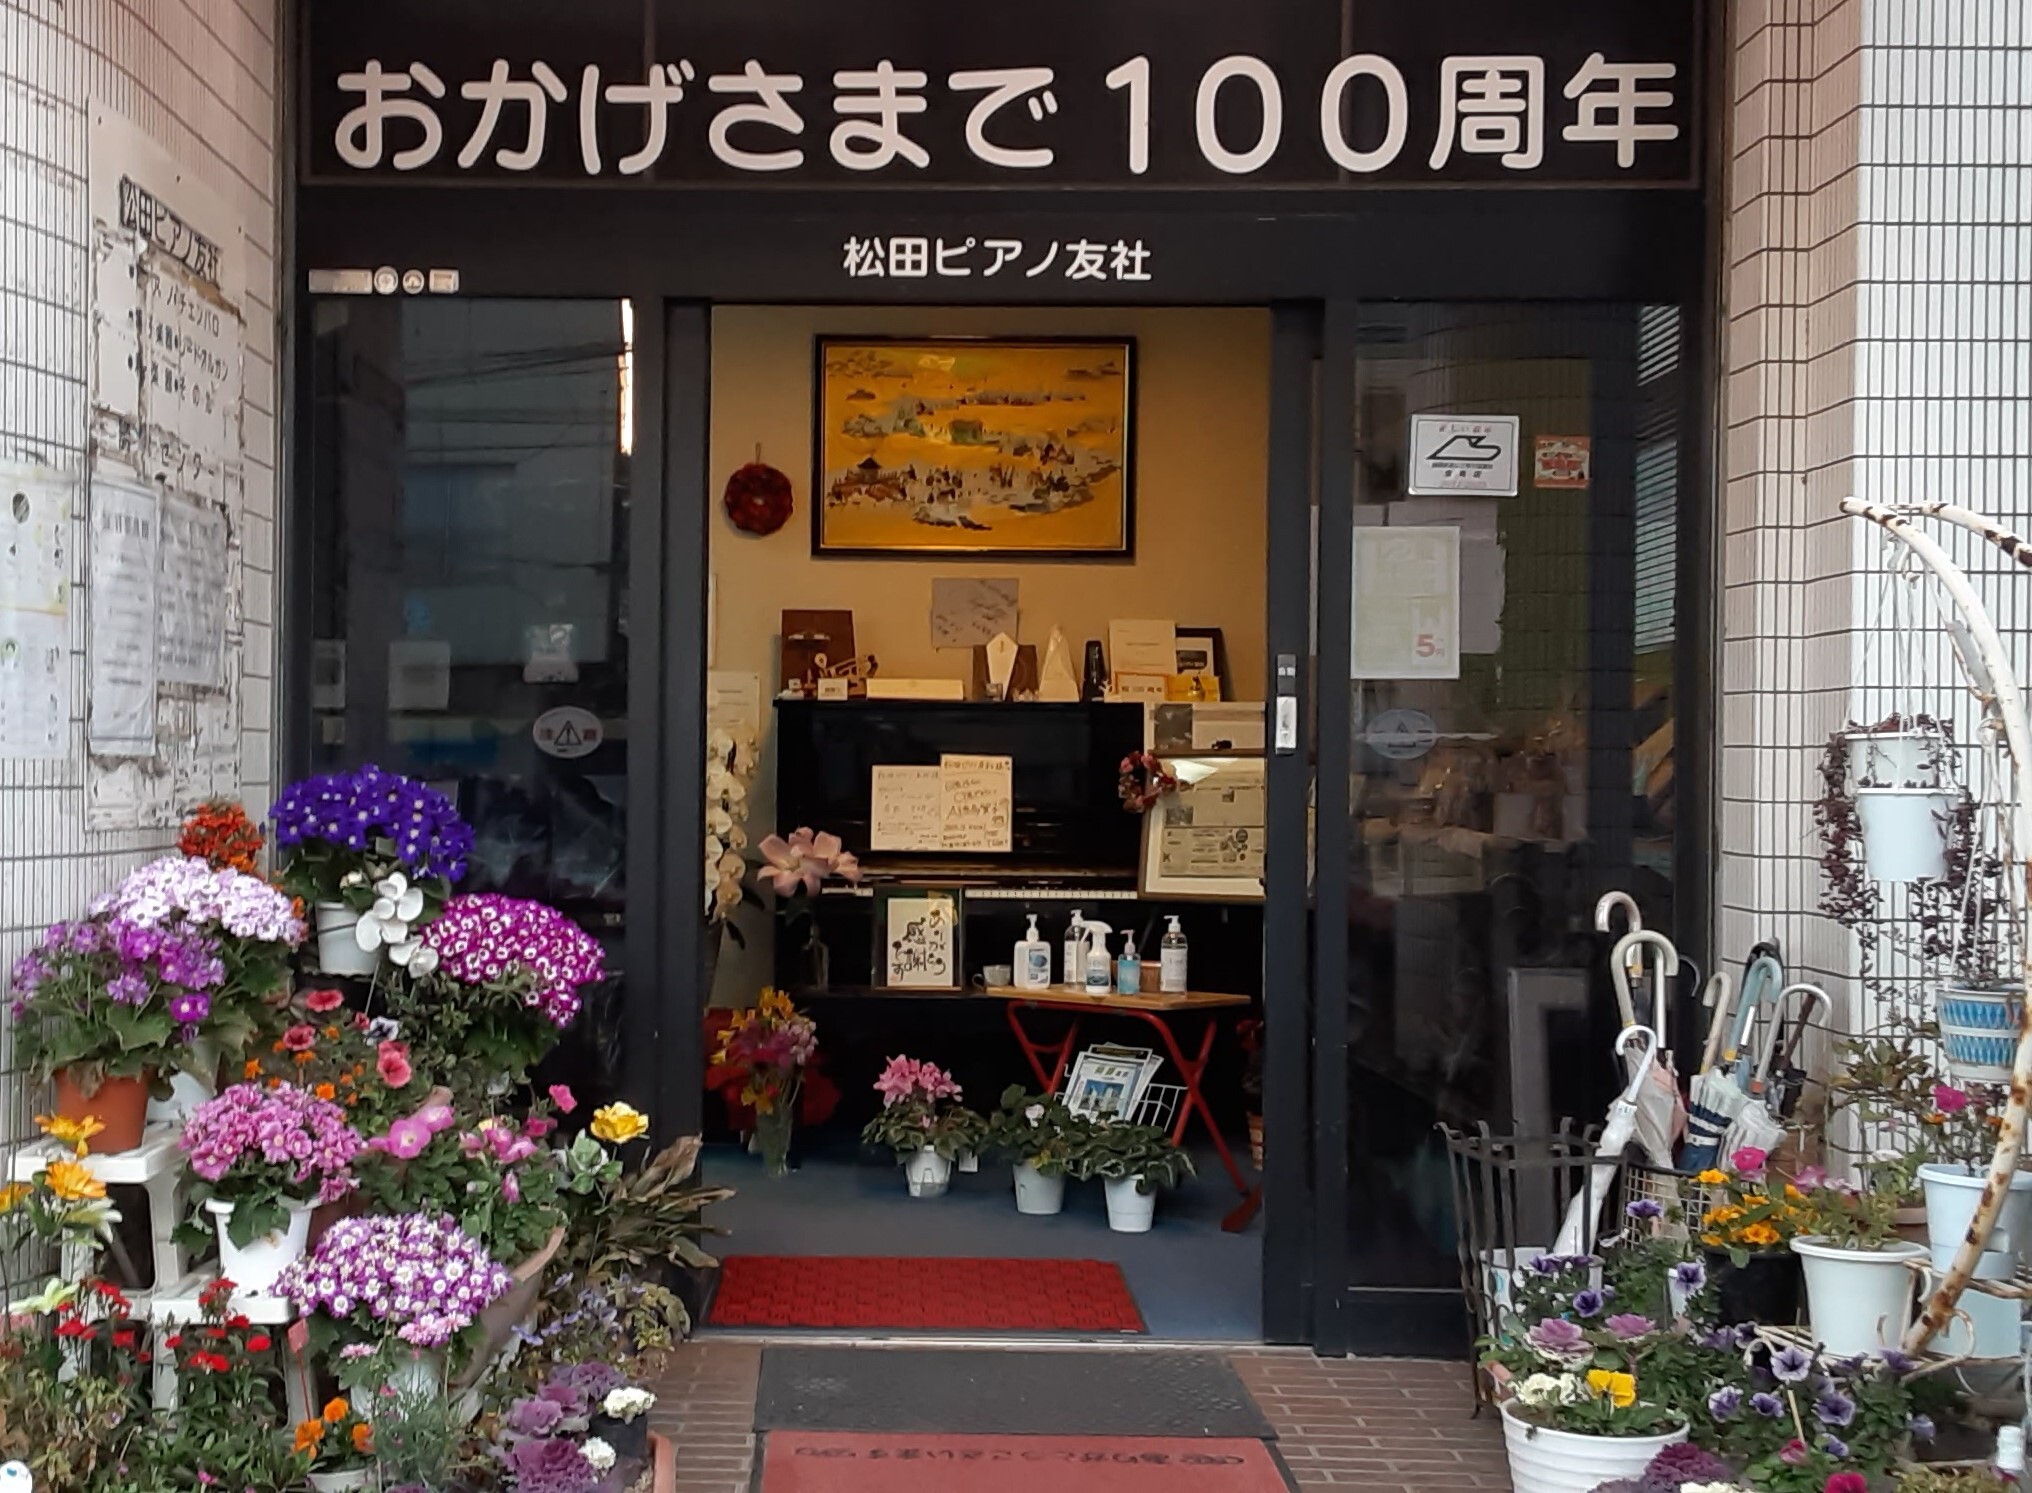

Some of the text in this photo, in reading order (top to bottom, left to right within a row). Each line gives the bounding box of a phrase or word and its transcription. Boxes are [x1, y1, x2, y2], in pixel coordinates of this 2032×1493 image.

[335, 53, 1679, 175] おかげさまで100周年
[843, 237, 1152, 280] 松田ピアノ友社
